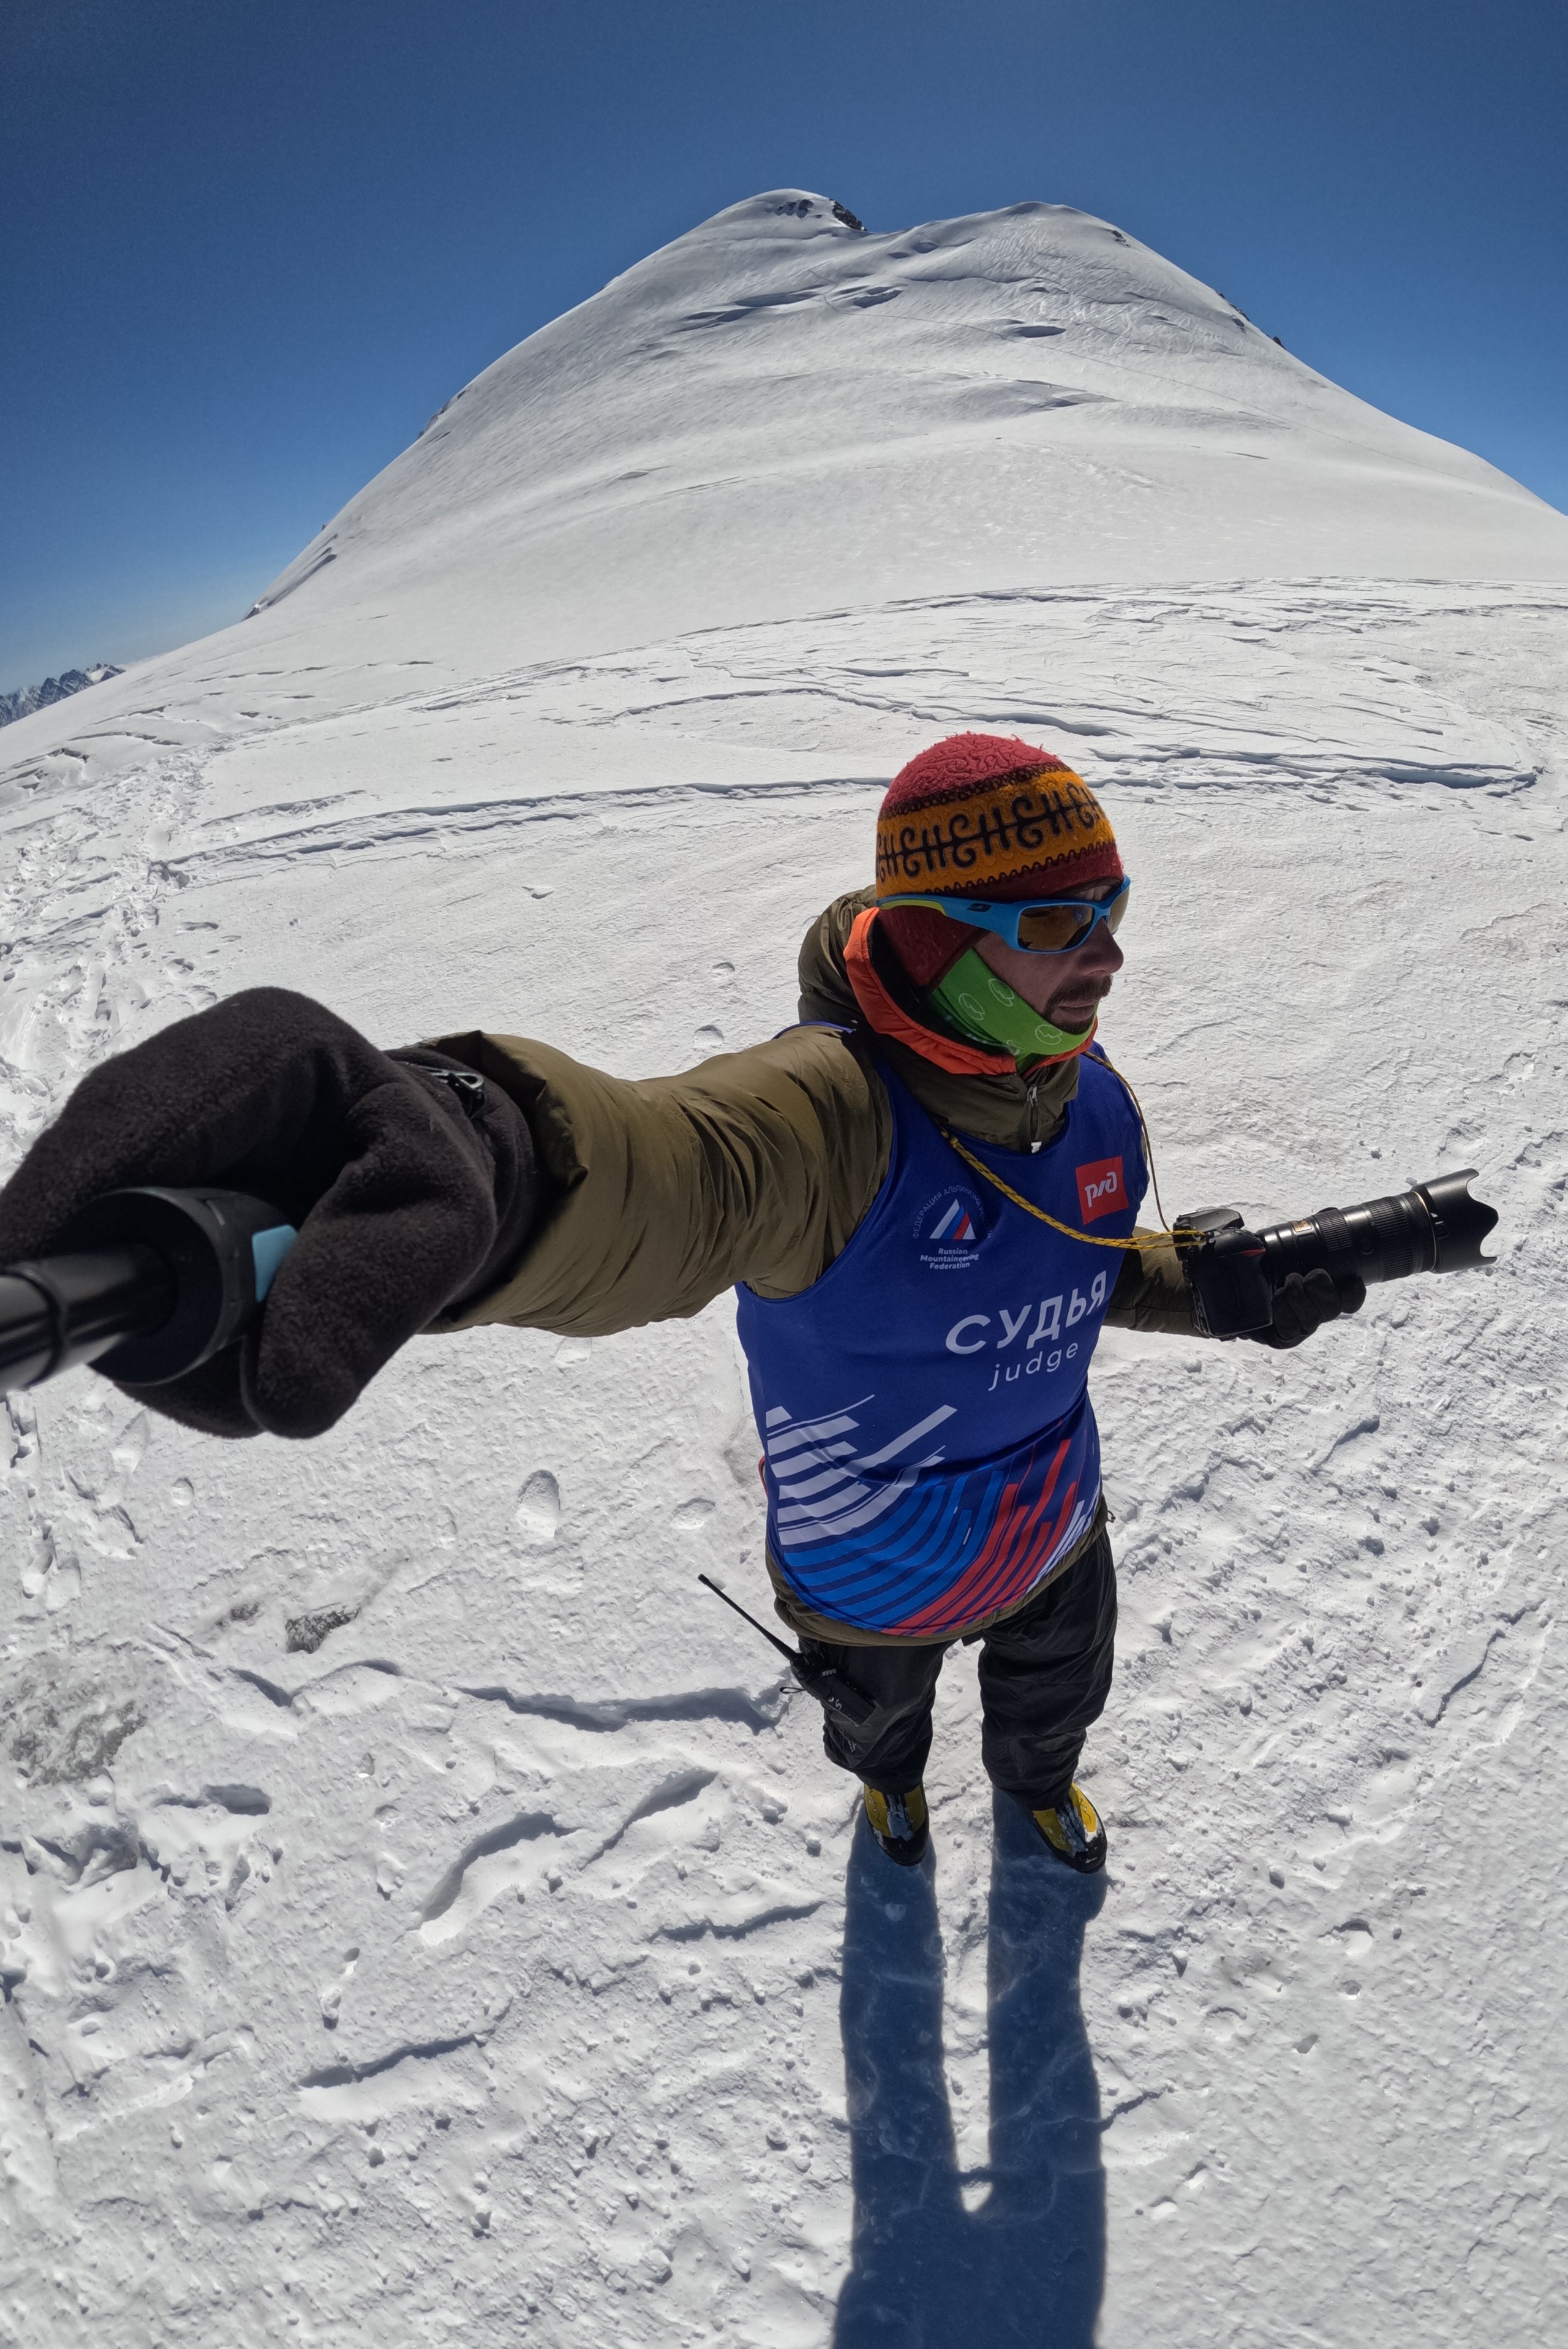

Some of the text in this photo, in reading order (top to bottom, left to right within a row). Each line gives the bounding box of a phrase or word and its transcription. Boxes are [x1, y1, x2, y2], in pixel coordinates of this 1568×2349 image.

[913, 1192, 942, 1239] ФЕДЕРАЦИЯ
[943, 1185, 980, 1206] АЛЬПИНИЗМА
[946, 1270, 1106, 1355] СУДЬЯ
[988, 1342, 1078, 1391] judge
